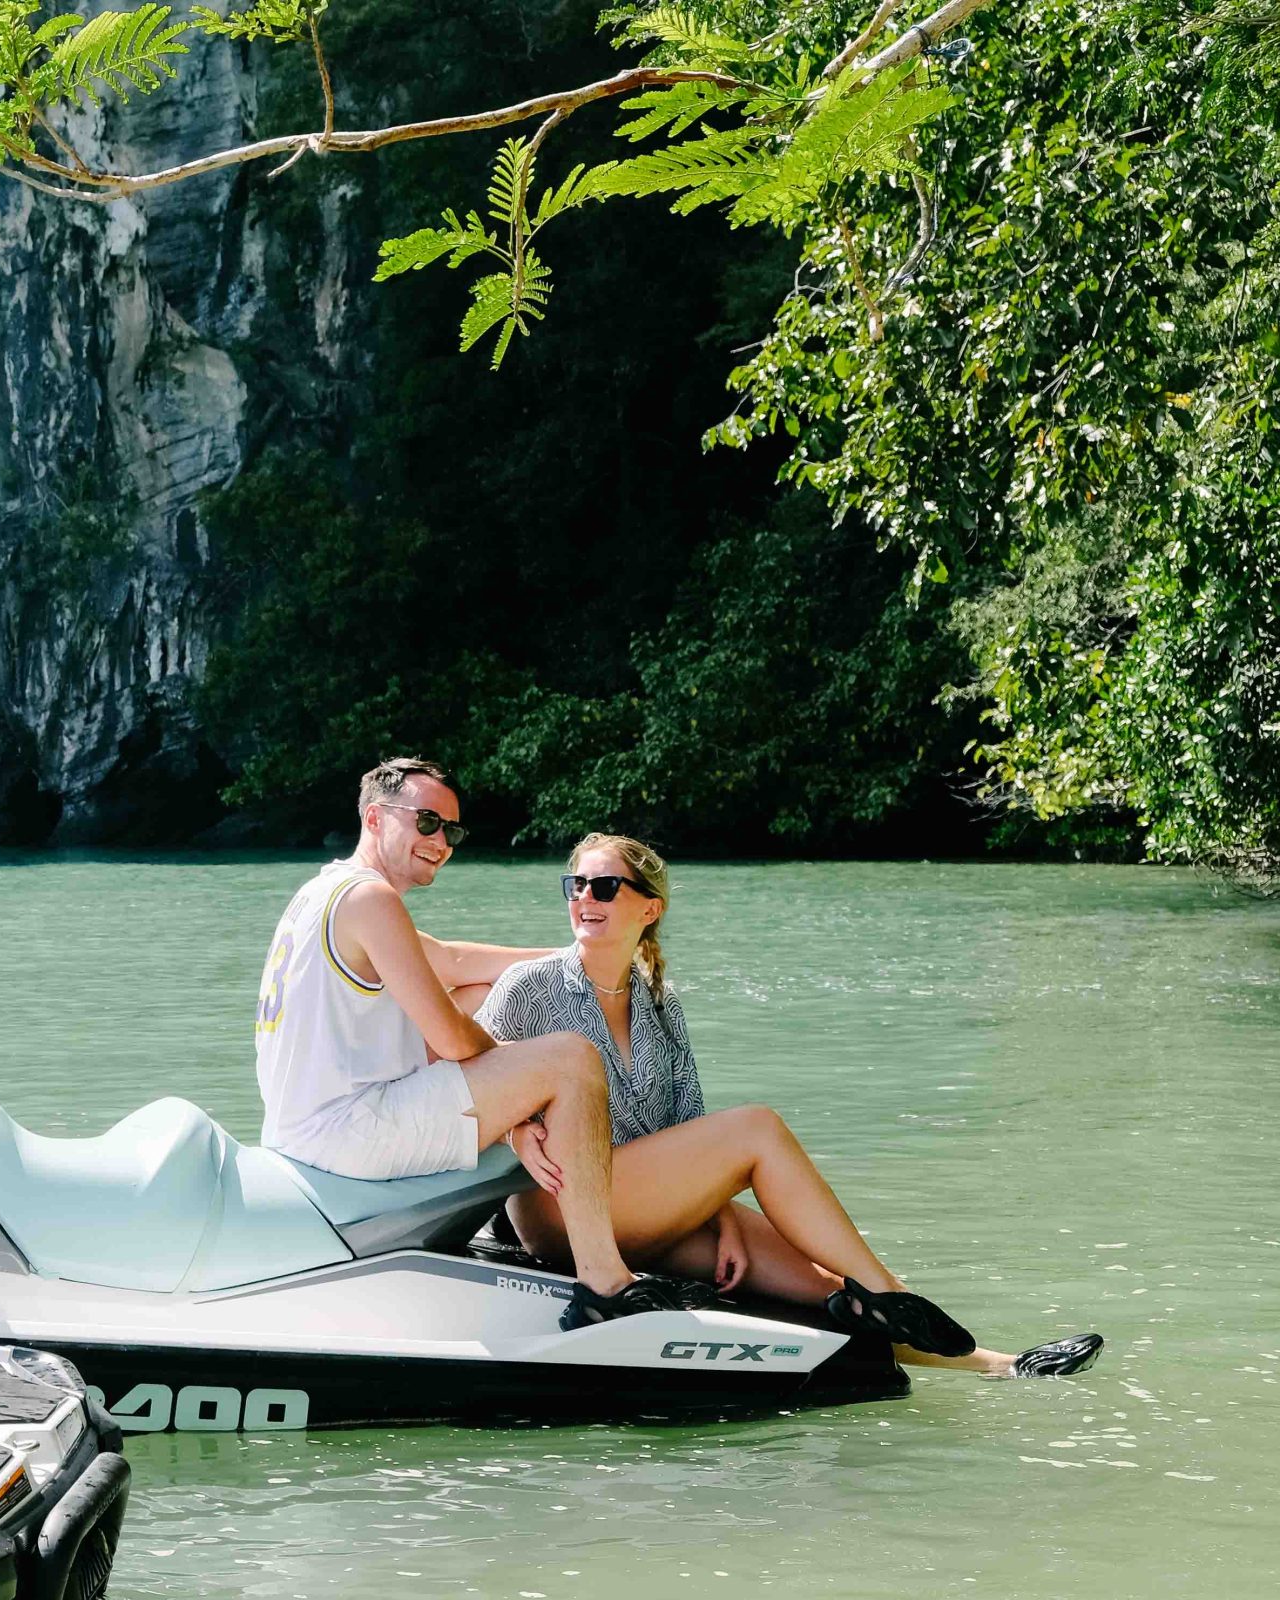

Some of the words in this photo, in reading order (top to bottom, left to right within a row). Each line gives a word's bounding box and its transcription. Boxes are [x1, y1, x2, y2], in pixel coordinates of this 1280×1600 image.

[496, 1276, 553, 1298] ROTAX
[660, 1341, 770, 1362] GTX
[773, 1347, 800, 1355] PRO
